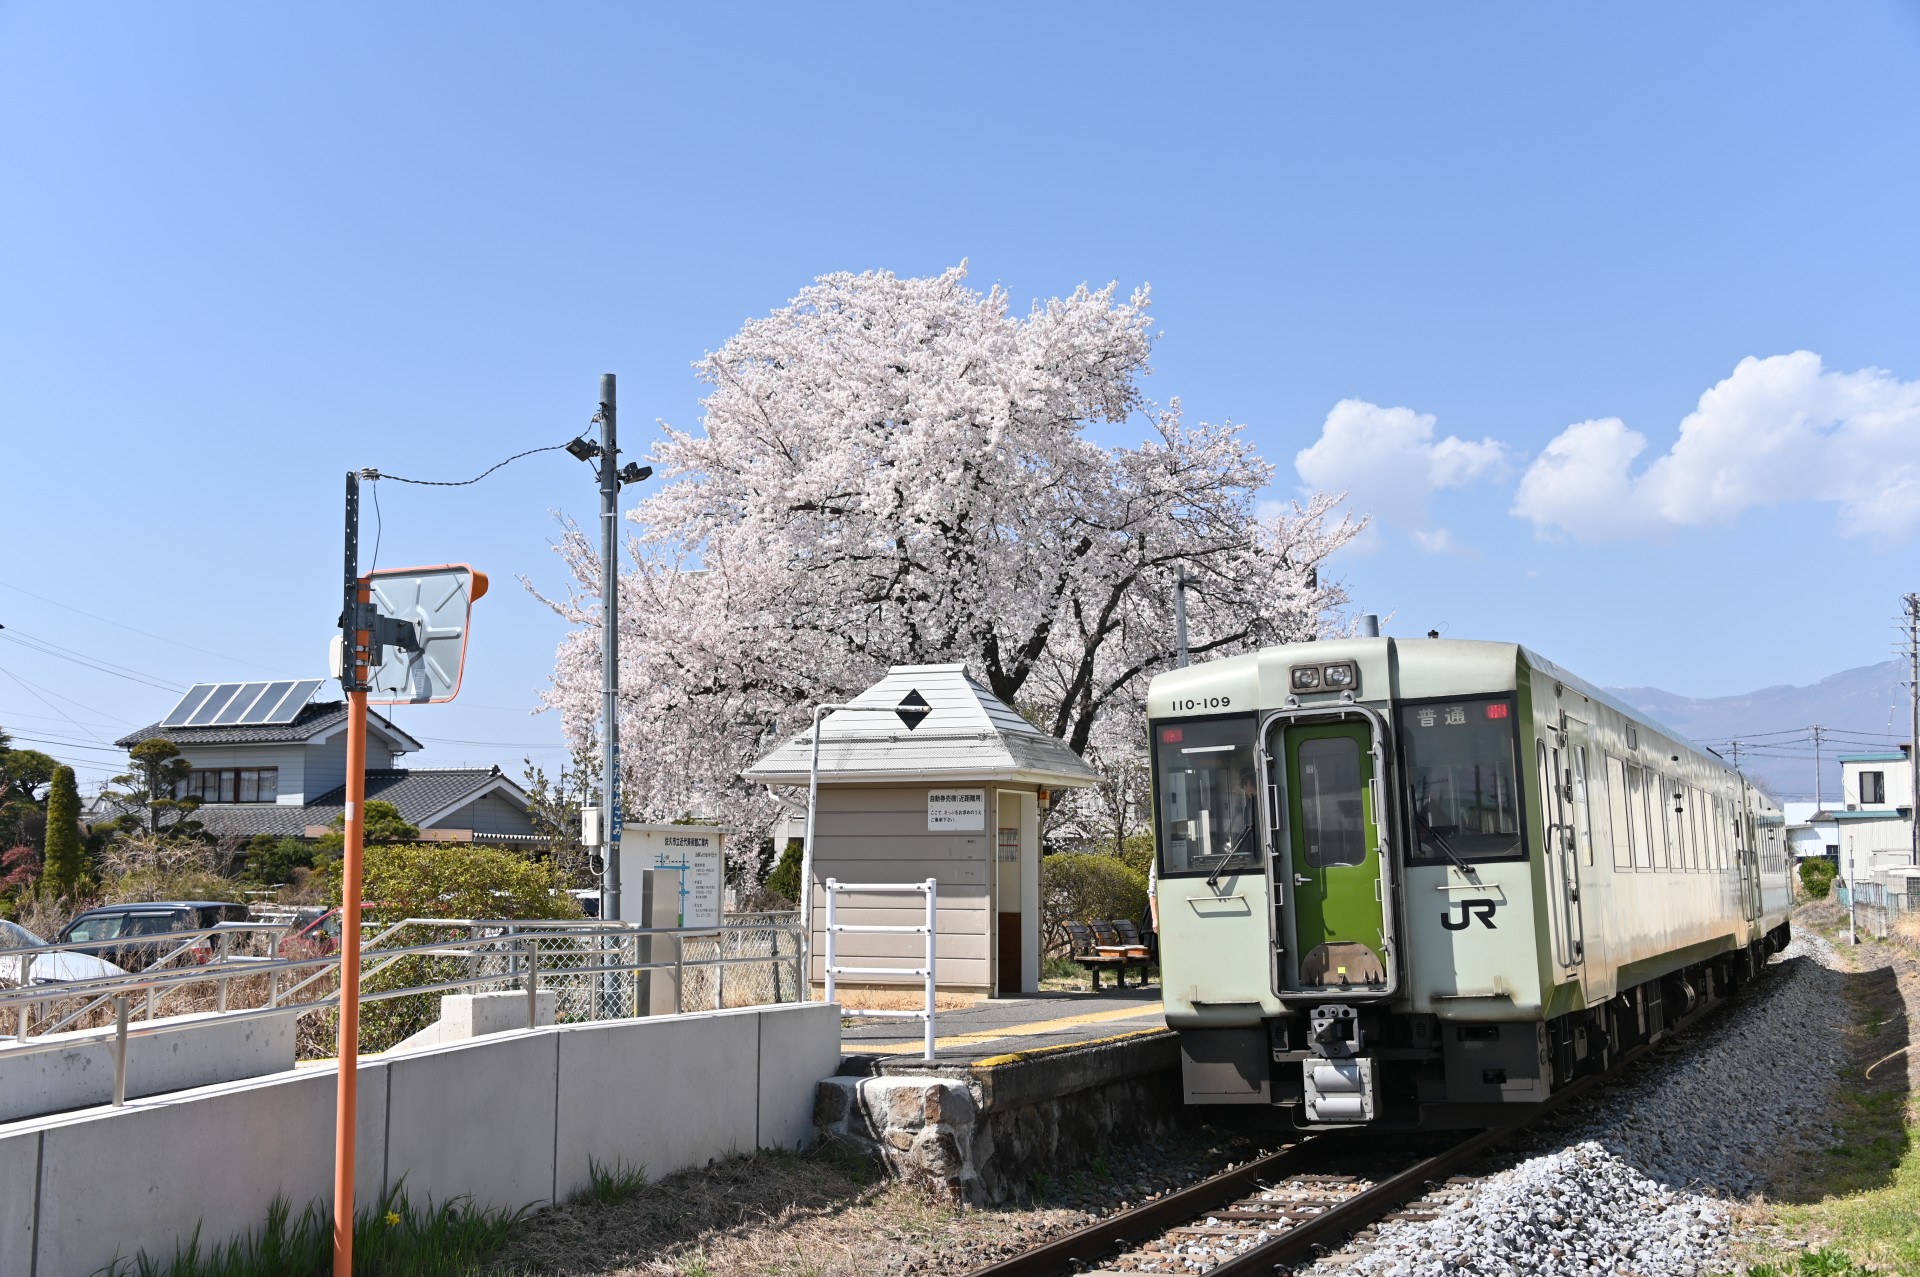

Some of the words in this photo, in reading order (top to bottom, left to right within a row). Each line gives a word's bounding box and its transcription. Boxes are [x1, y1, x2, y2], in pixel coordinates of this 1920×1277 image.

[1172, 697, 1231, 711] 110-109
[1416, 706, 1466, 727] 普通
[1440, 899, 1498, 931] JR
